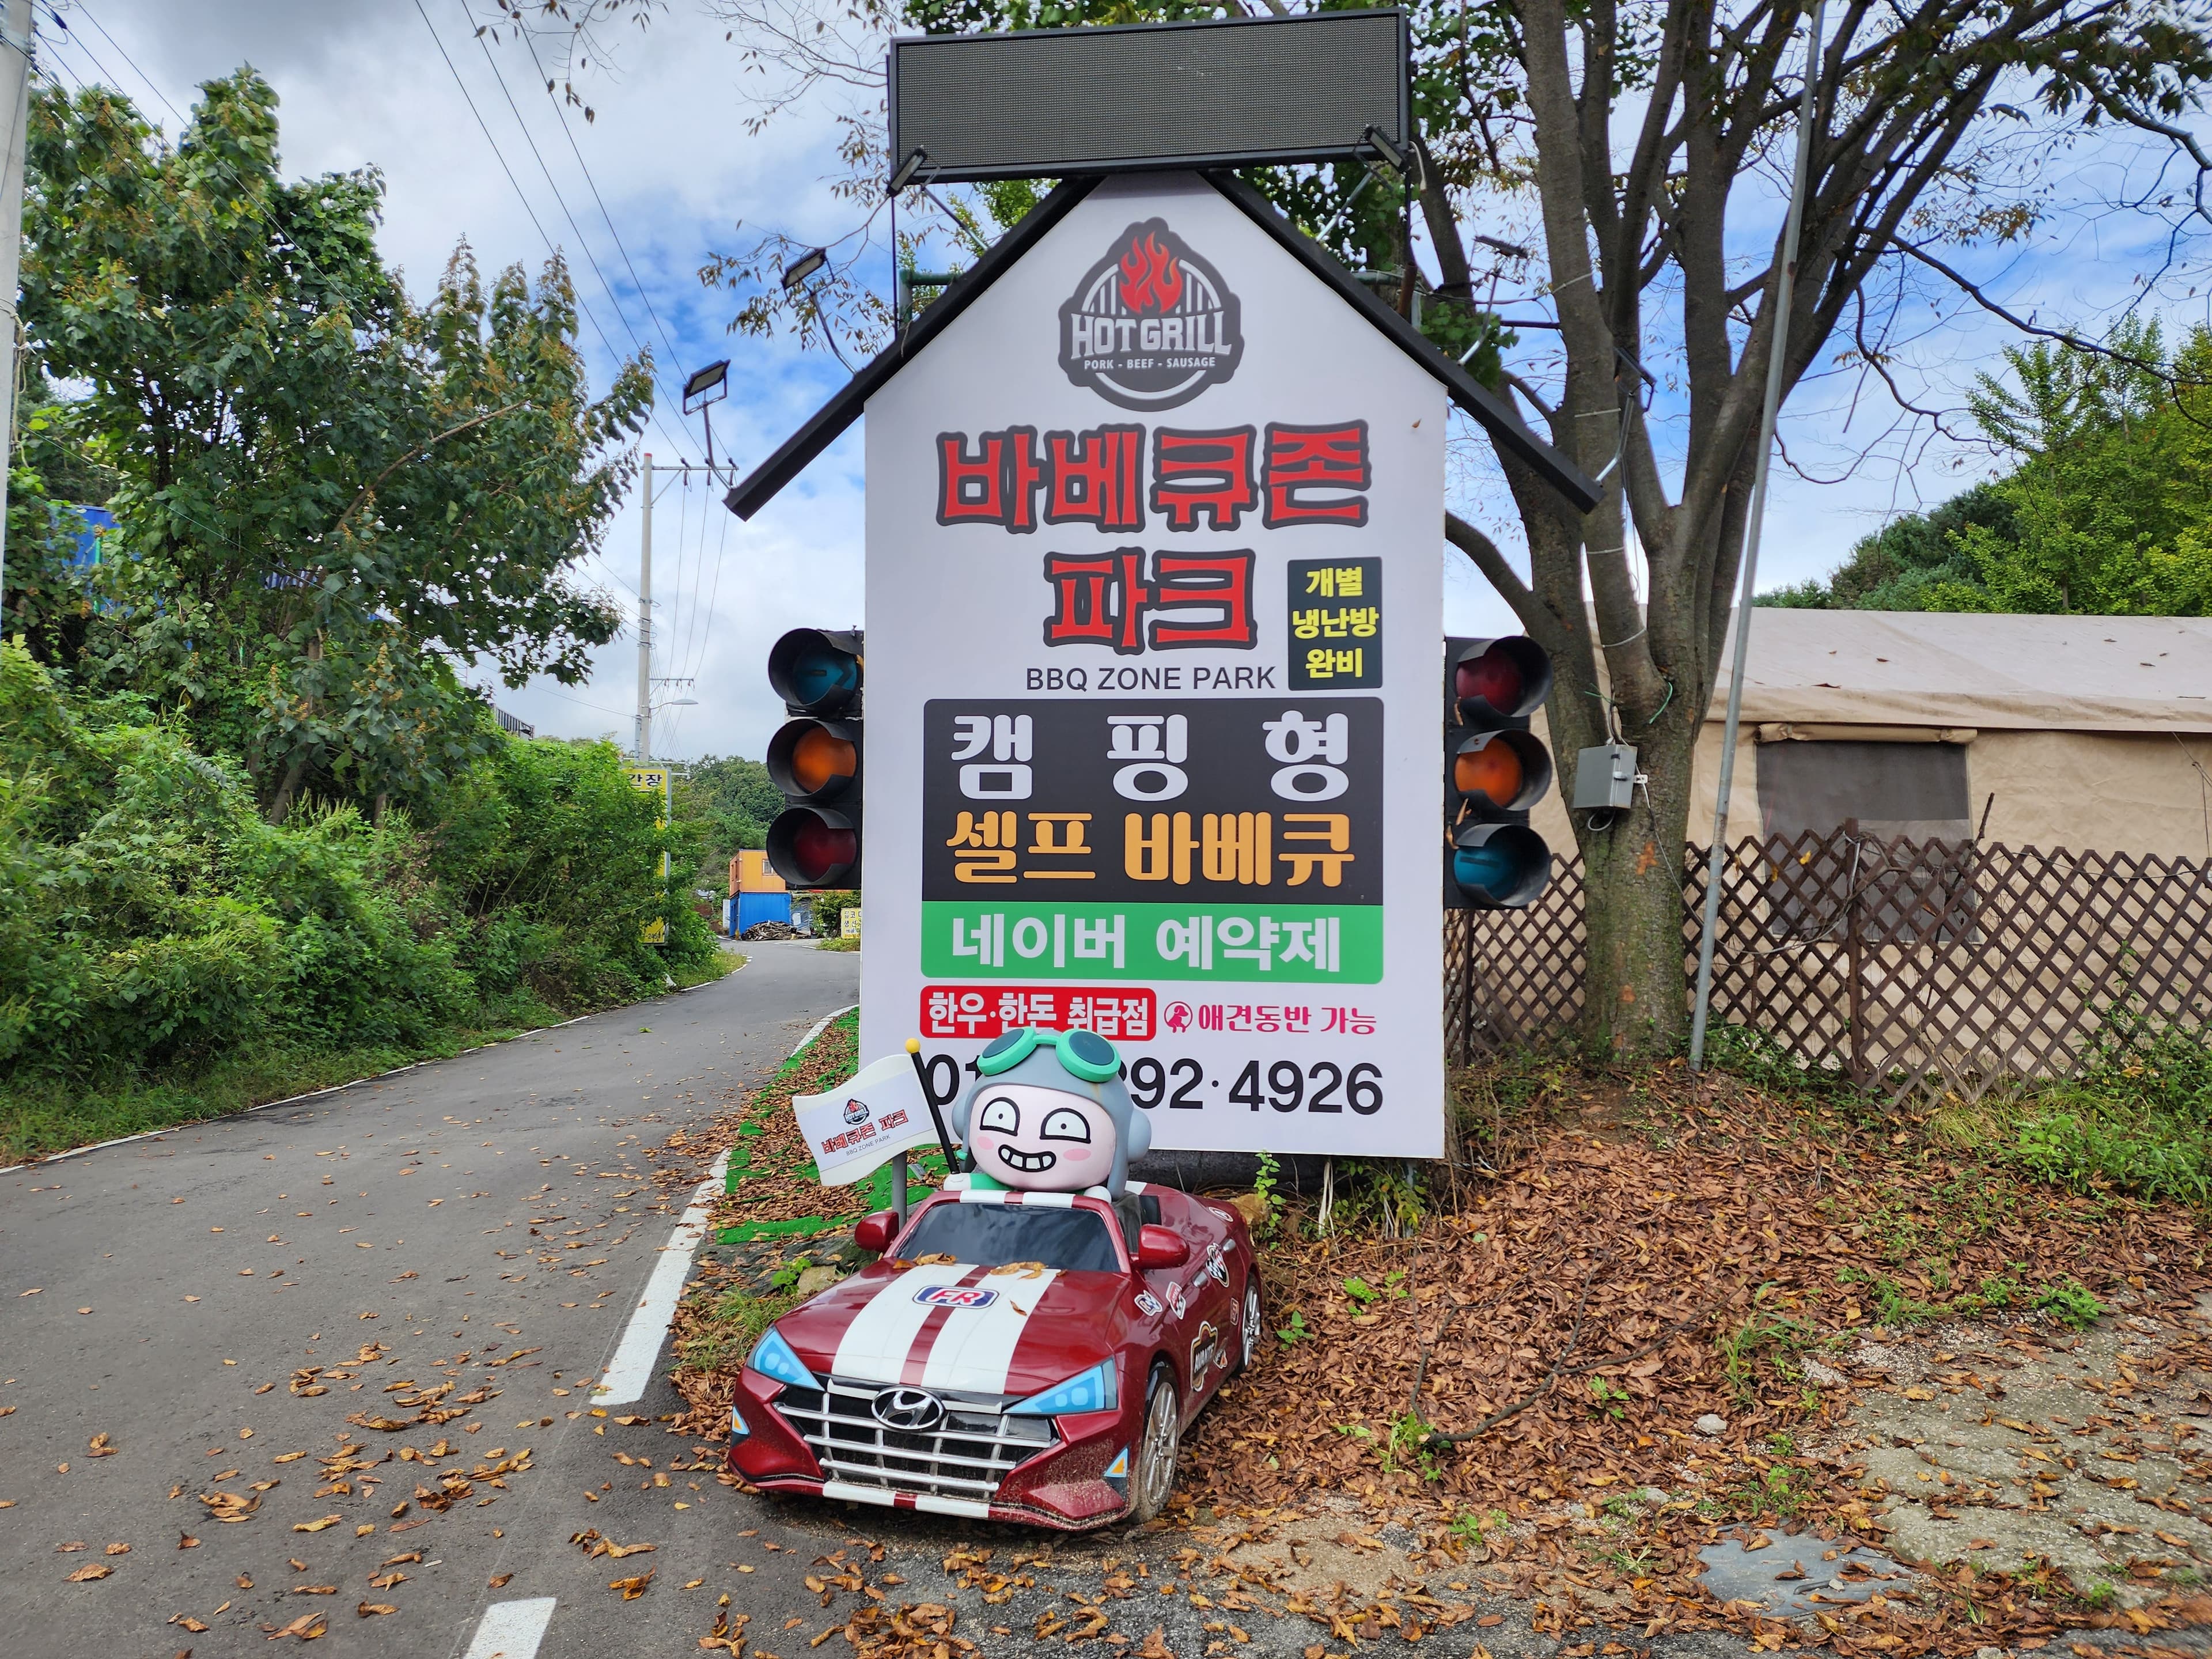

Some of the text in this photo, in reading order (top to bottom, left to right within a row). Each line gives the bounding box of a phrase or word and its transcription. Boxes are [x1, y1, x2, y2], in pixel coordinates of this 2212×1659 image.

[1070, 310, 1232, 359] HOT GRILL
[1084, 357, 1216, 370] PORK BEEF SAUSAGE
[936, 419, 1372, 535] 바베큐존
[1308, 567, 1363, 597] 개별
[1043, 546, 1258, 656] 파크
[1293, 608, 1378, 639] 냉난방
[1027, 666, 1276, 692] BBQ ZONE PARK
[1305, 649, 1363, 679] 완비
[946, 810, 1355, 887] 셀프 바베큐
[952, 914, 1340, 972] 네이버 예약제
[1067, 997, 1148, 1036] 취급점
[1198, 1005, 1377, 1035] 애견동반 가능
[821, 1109, 909, 1154] 바베큐존 파크
[846, 1134, 891, 1156] BBQ ZONE PARK
[928, 1289, 983, 1304] FR
